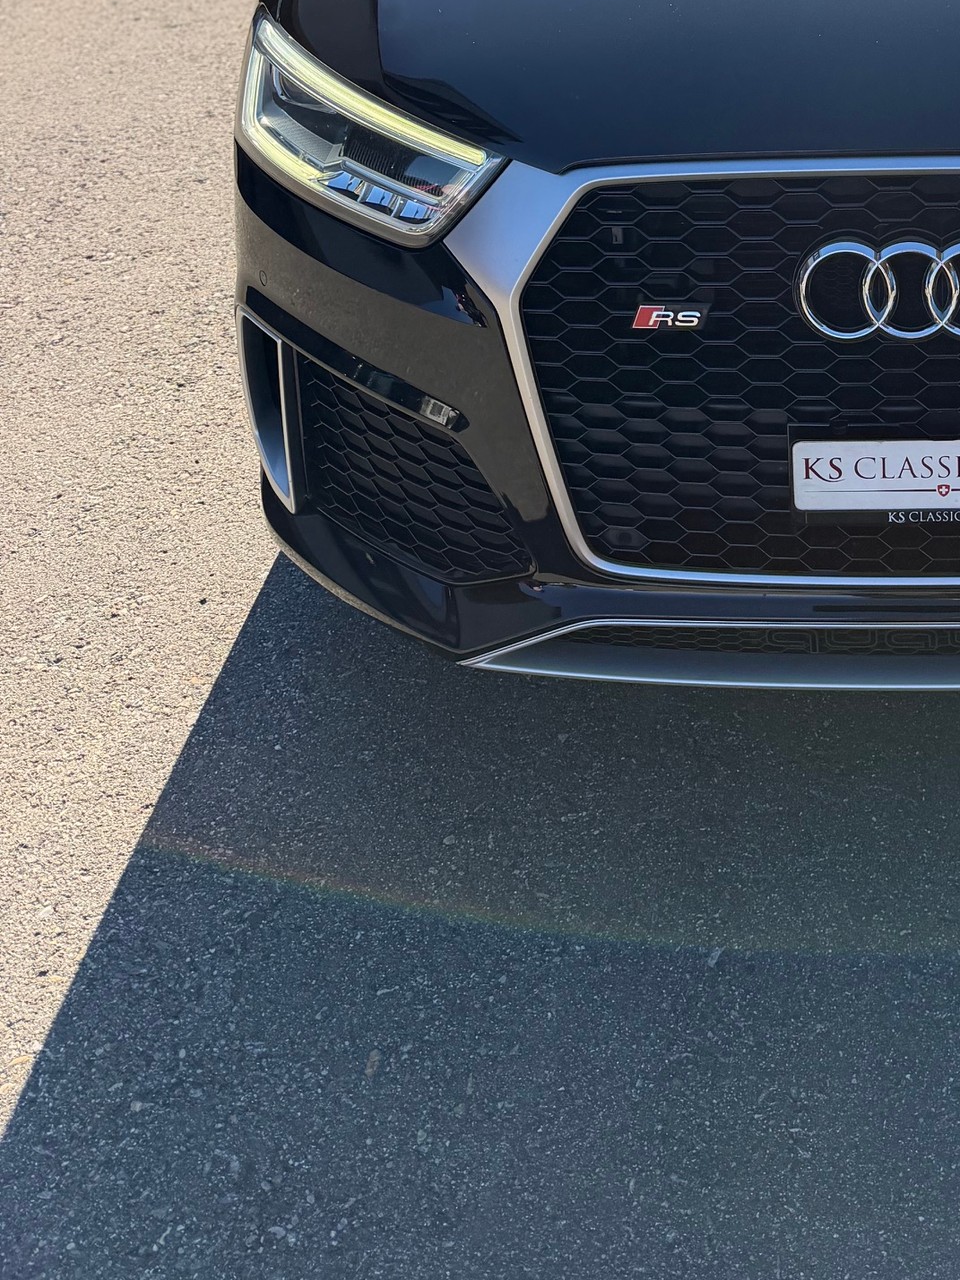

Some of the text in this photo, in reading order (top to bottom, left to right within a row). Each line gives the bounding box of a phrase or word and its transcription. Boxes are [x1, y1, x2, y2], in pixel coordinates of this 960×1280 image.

[648, 311, 701, 326] RS
[802, 456, 846, 483] KS
[887, 511, 906, 524] KS
